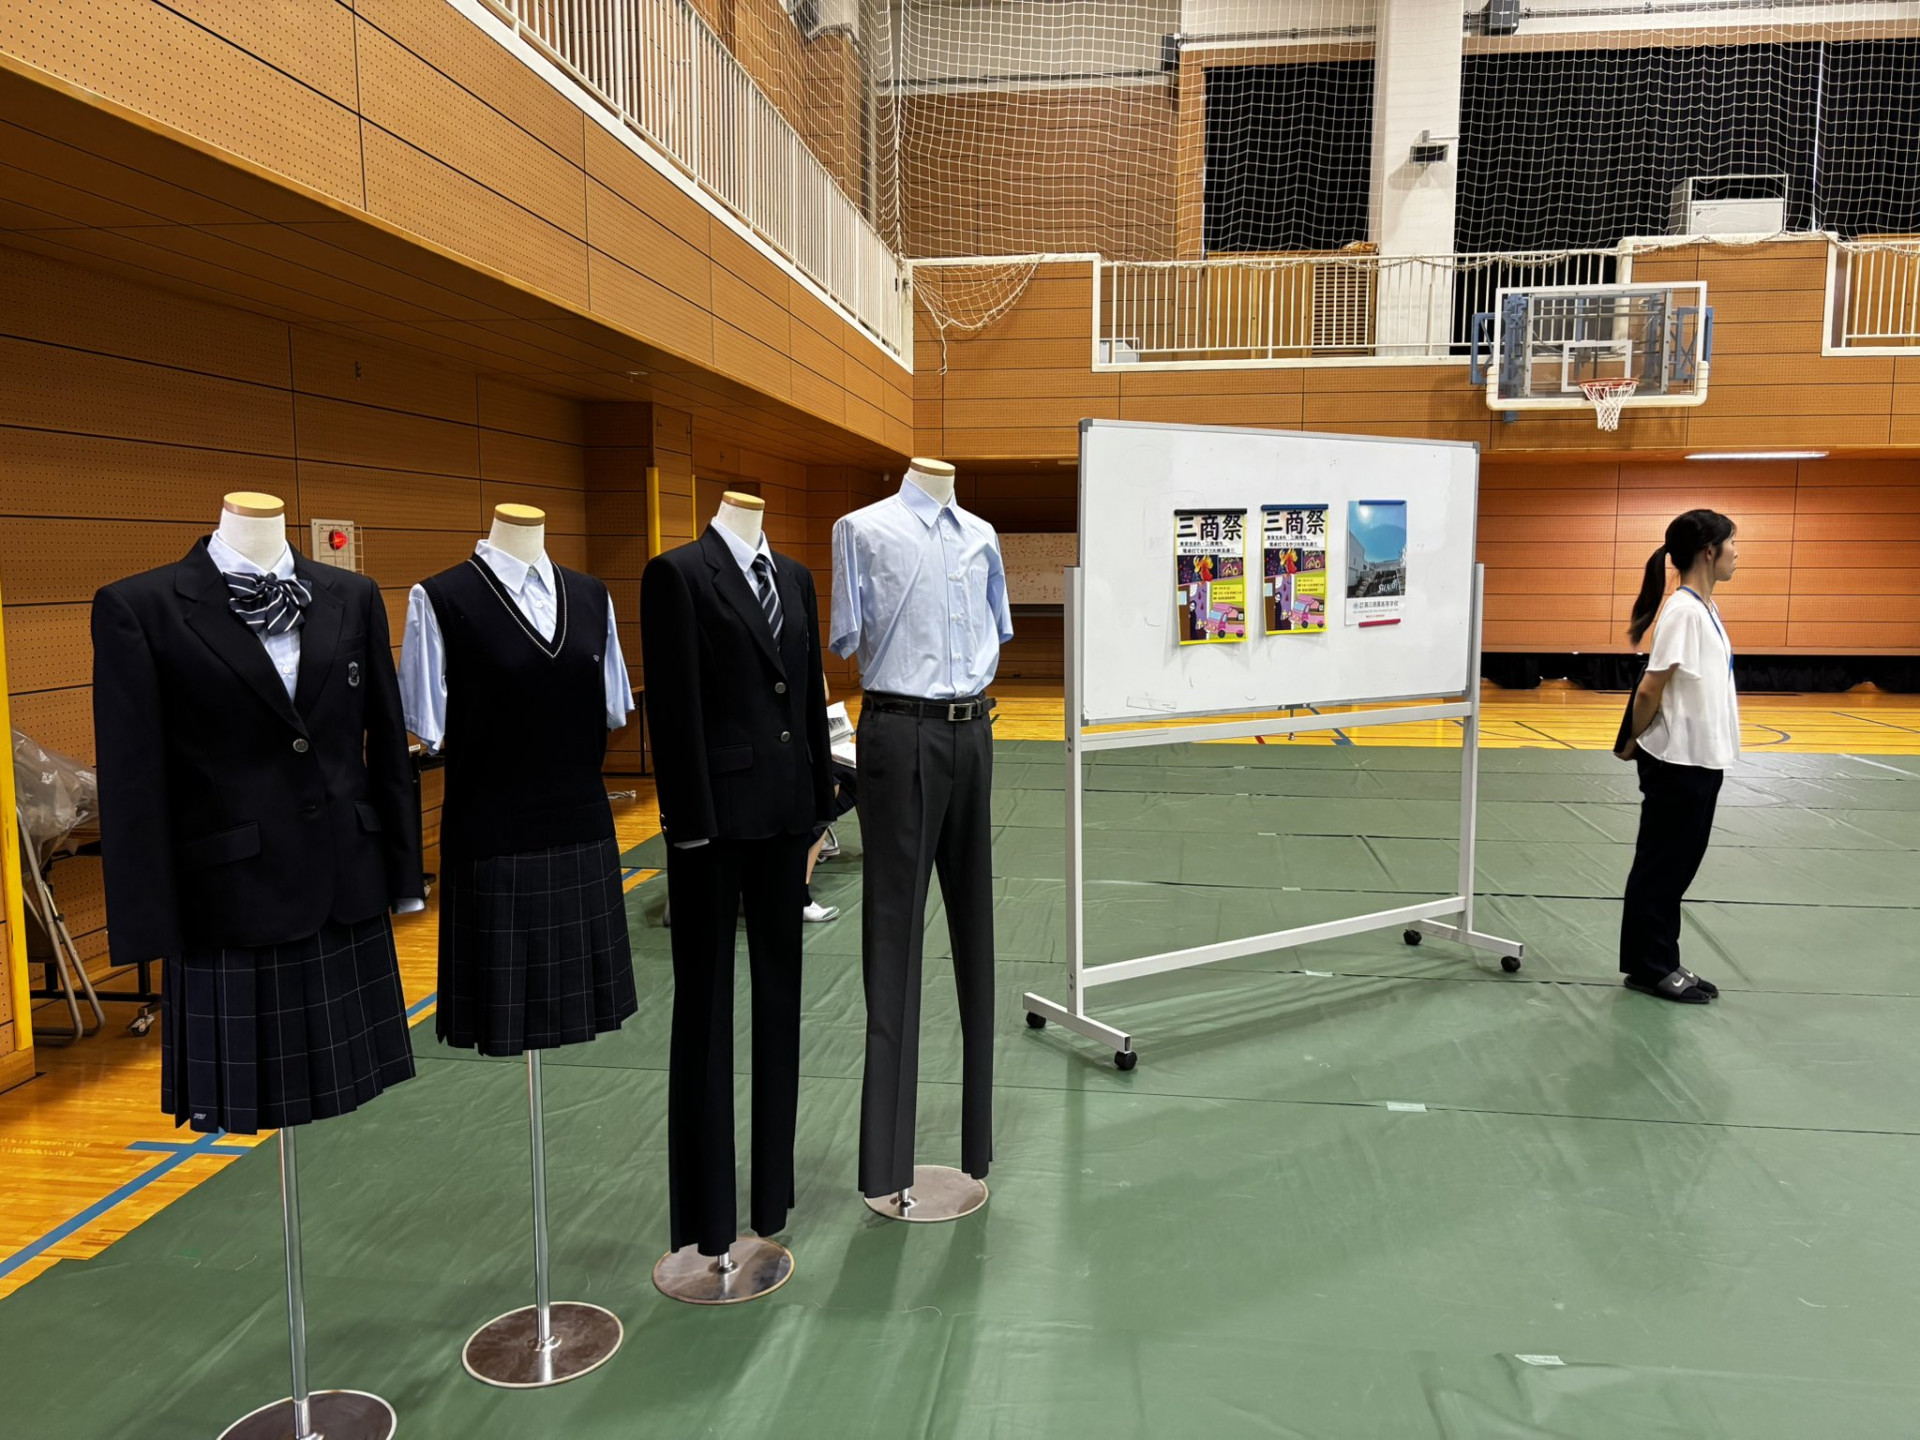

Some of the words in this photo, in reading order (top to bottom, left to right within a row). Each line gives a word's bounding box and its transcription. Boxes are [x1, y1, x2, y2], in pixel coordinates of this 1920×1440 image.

[1176, 514, 1243, 541] 三商祭
[1264, 510, 1326, 535] 三商祭
